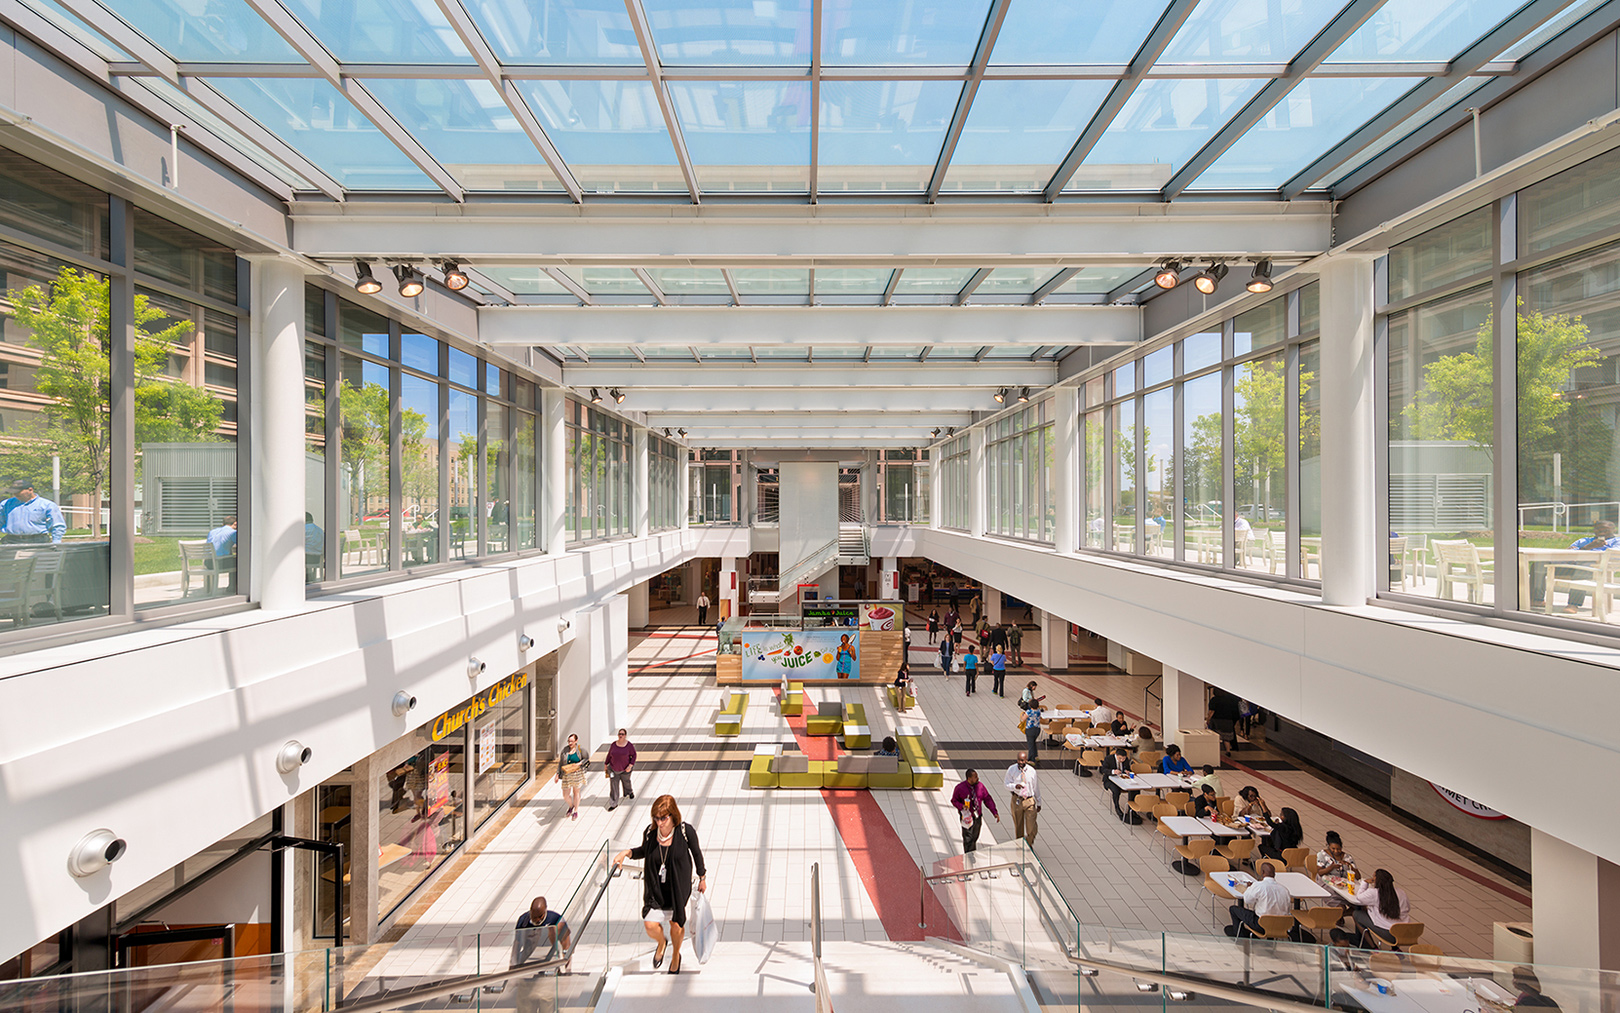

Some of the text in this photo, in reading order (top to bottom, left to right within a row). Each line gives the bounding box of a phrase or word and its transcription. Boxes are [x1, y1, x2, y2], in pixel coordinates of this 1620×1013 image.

[781, 651, 812, 668] JUICE
[432, 672, 527, 742] Church's Chicken
